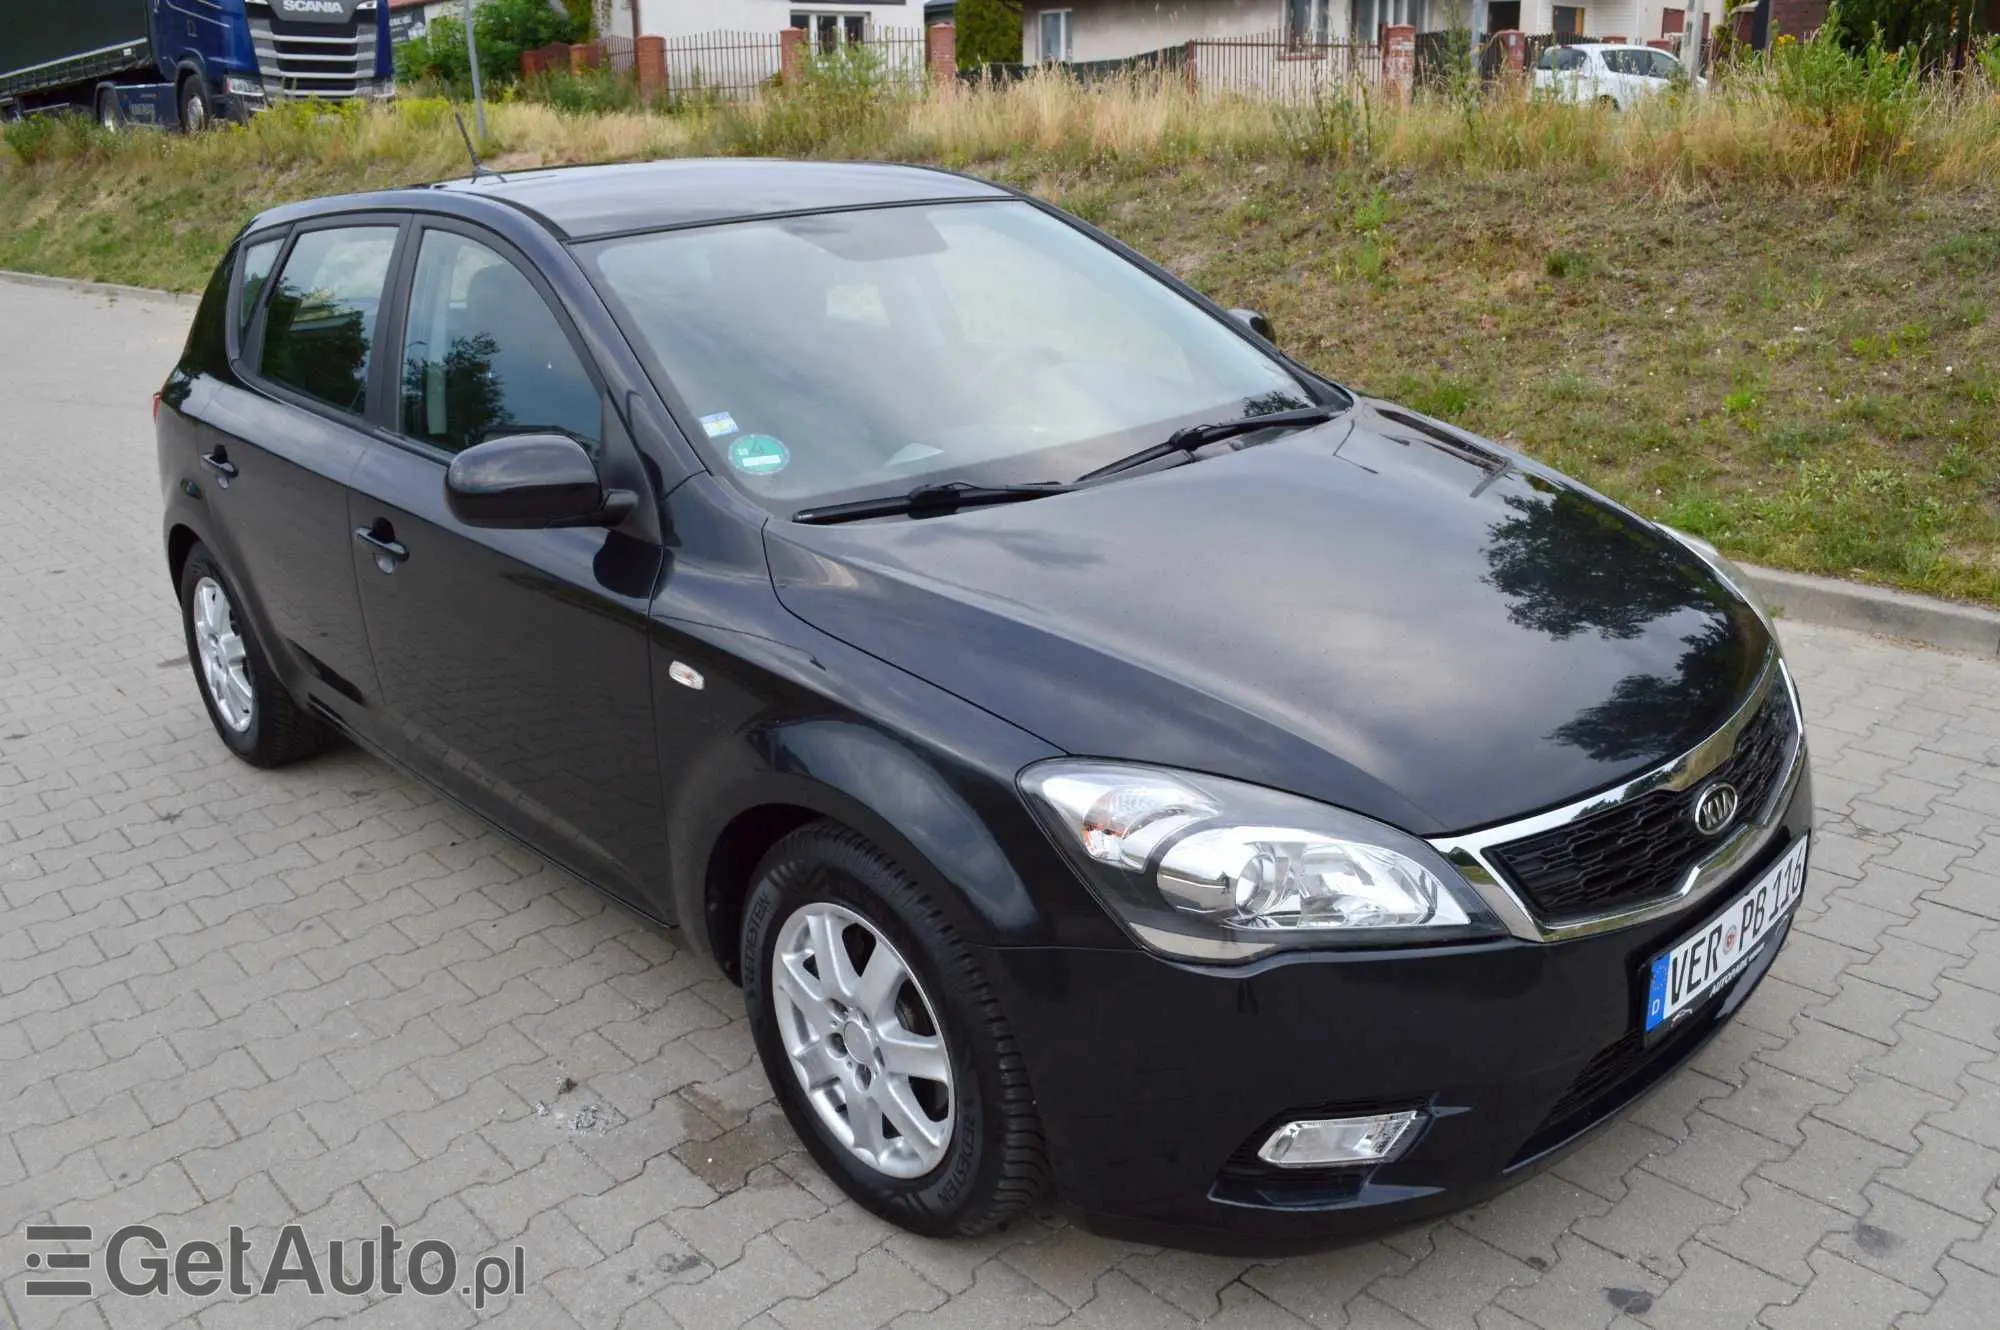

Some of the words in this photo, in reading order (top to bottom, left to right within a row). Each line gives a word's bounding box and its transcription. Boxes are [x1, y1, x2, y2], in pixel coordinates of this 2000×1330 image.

[283, 0, 344, 14] SCANIA
[1702, 790, 1733, 828] KIA
[1671, 924, 1723, 1004] VER
[1739, 886, 1767, 952] PB
[1769, 845, 1803, 922] 116
[1651, 999, 1660, 1016] D
